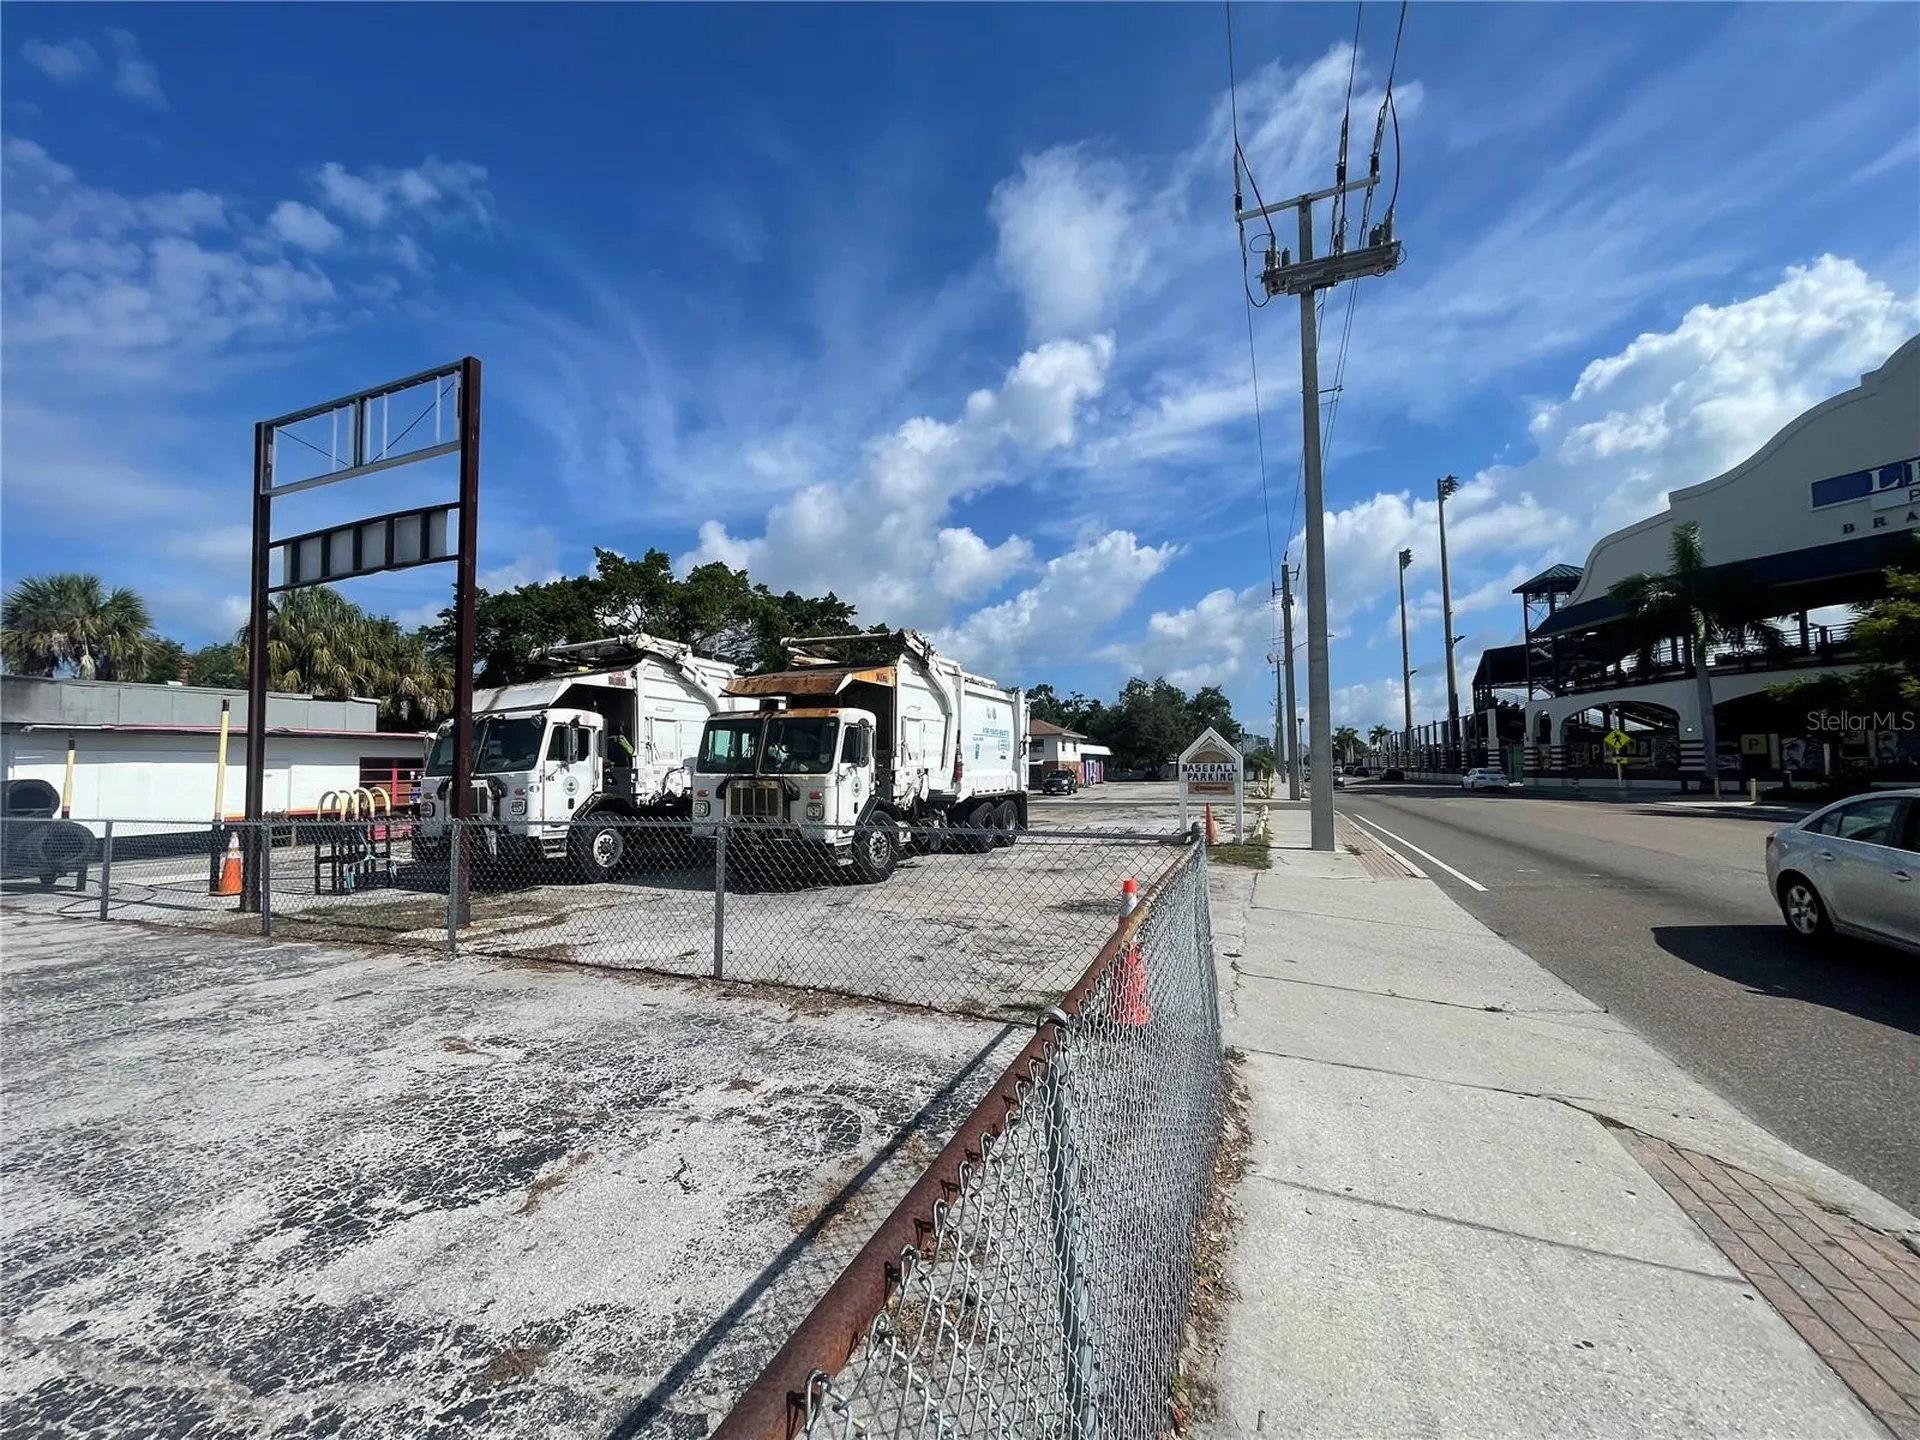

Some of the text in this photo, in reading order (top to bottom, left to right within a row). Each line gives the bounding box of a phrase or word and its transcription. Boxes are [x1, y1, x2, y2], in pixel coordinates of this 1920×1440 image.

[1748, 738, 1759, 751] P
[1182, 764, 1238, 773] BASEBALL
[1187, 773, 1234, 782] PARKING
